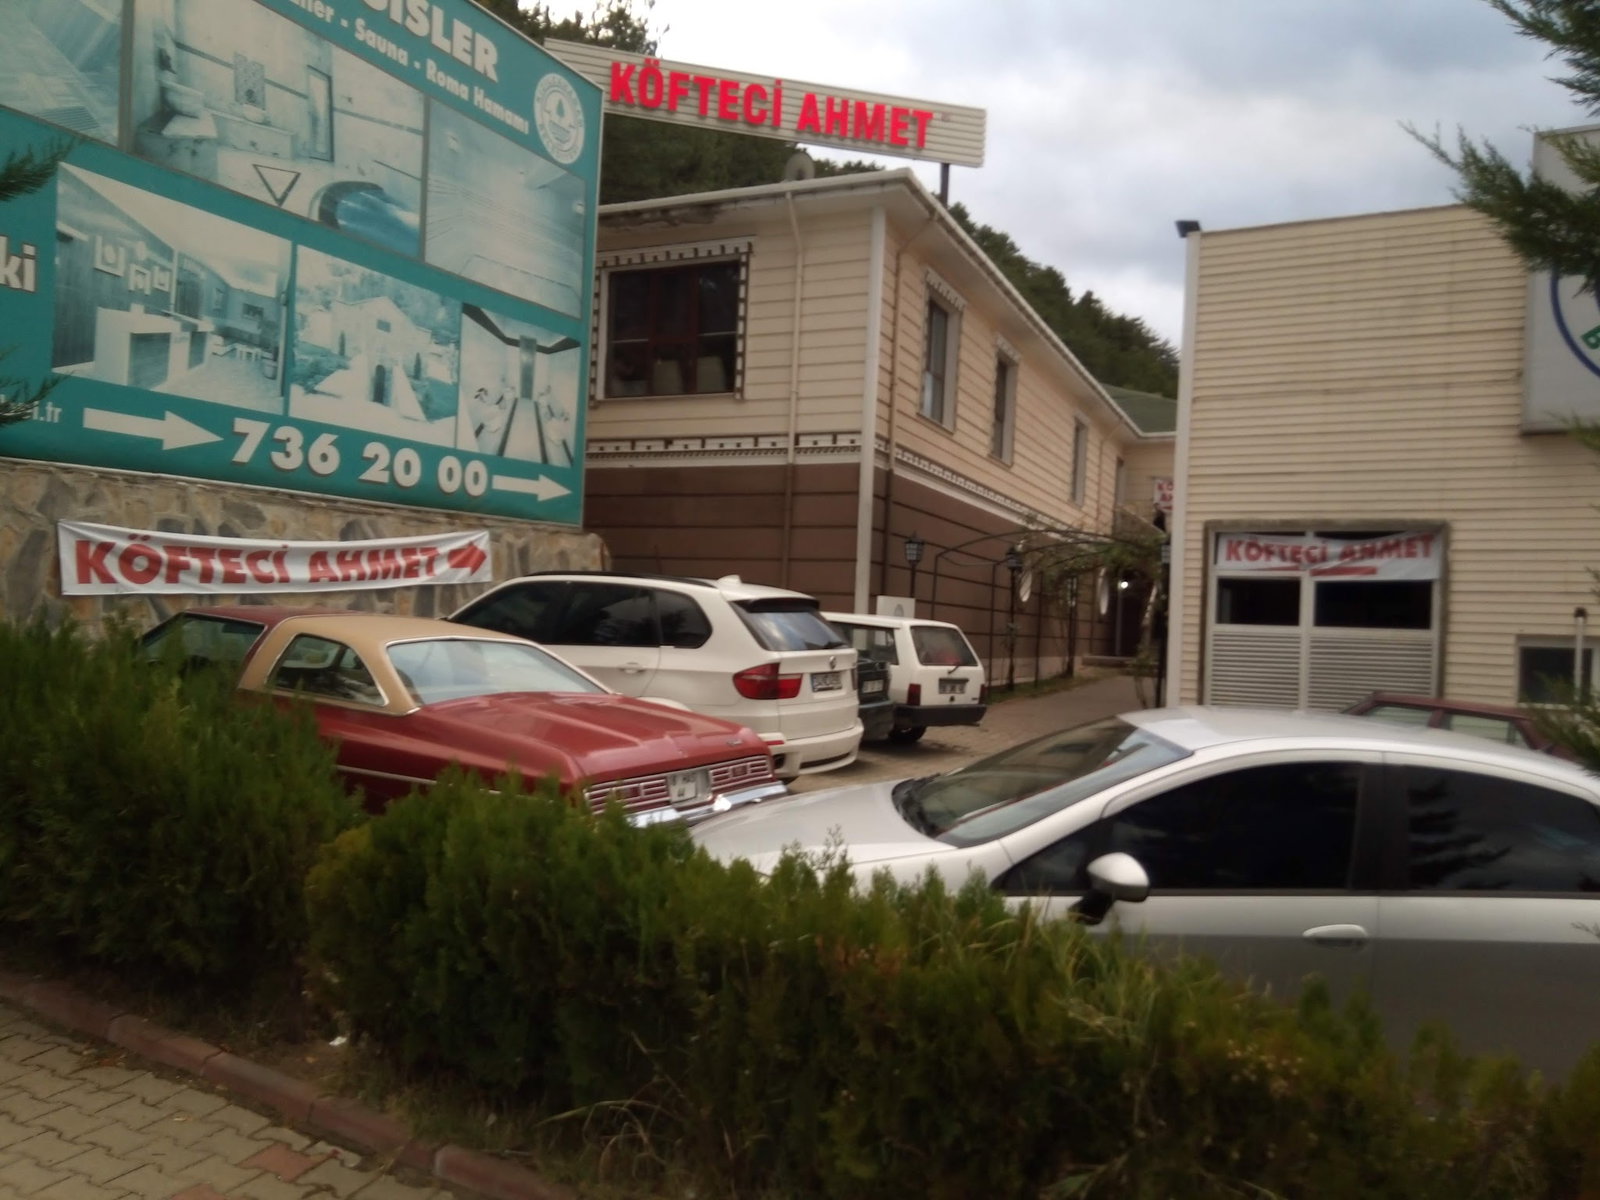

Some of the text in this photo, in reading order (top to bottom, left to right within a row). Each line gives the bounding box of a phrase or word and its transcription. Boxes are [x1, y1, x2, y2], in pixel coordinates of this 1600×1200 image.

[354, 18, 408, 66] Sauna
[426, 58, 469, 100] Roma
[610, 57, 782, 127] KÖFTECİ
[797, 92, 933, 149] AHMET
[231, 417, 488, 497] 736 20 00
[75, 534, 440, 585] KÖFTECİ AHMET
[1226, 532, 1436, 563] KÖFTECİ AHMET
